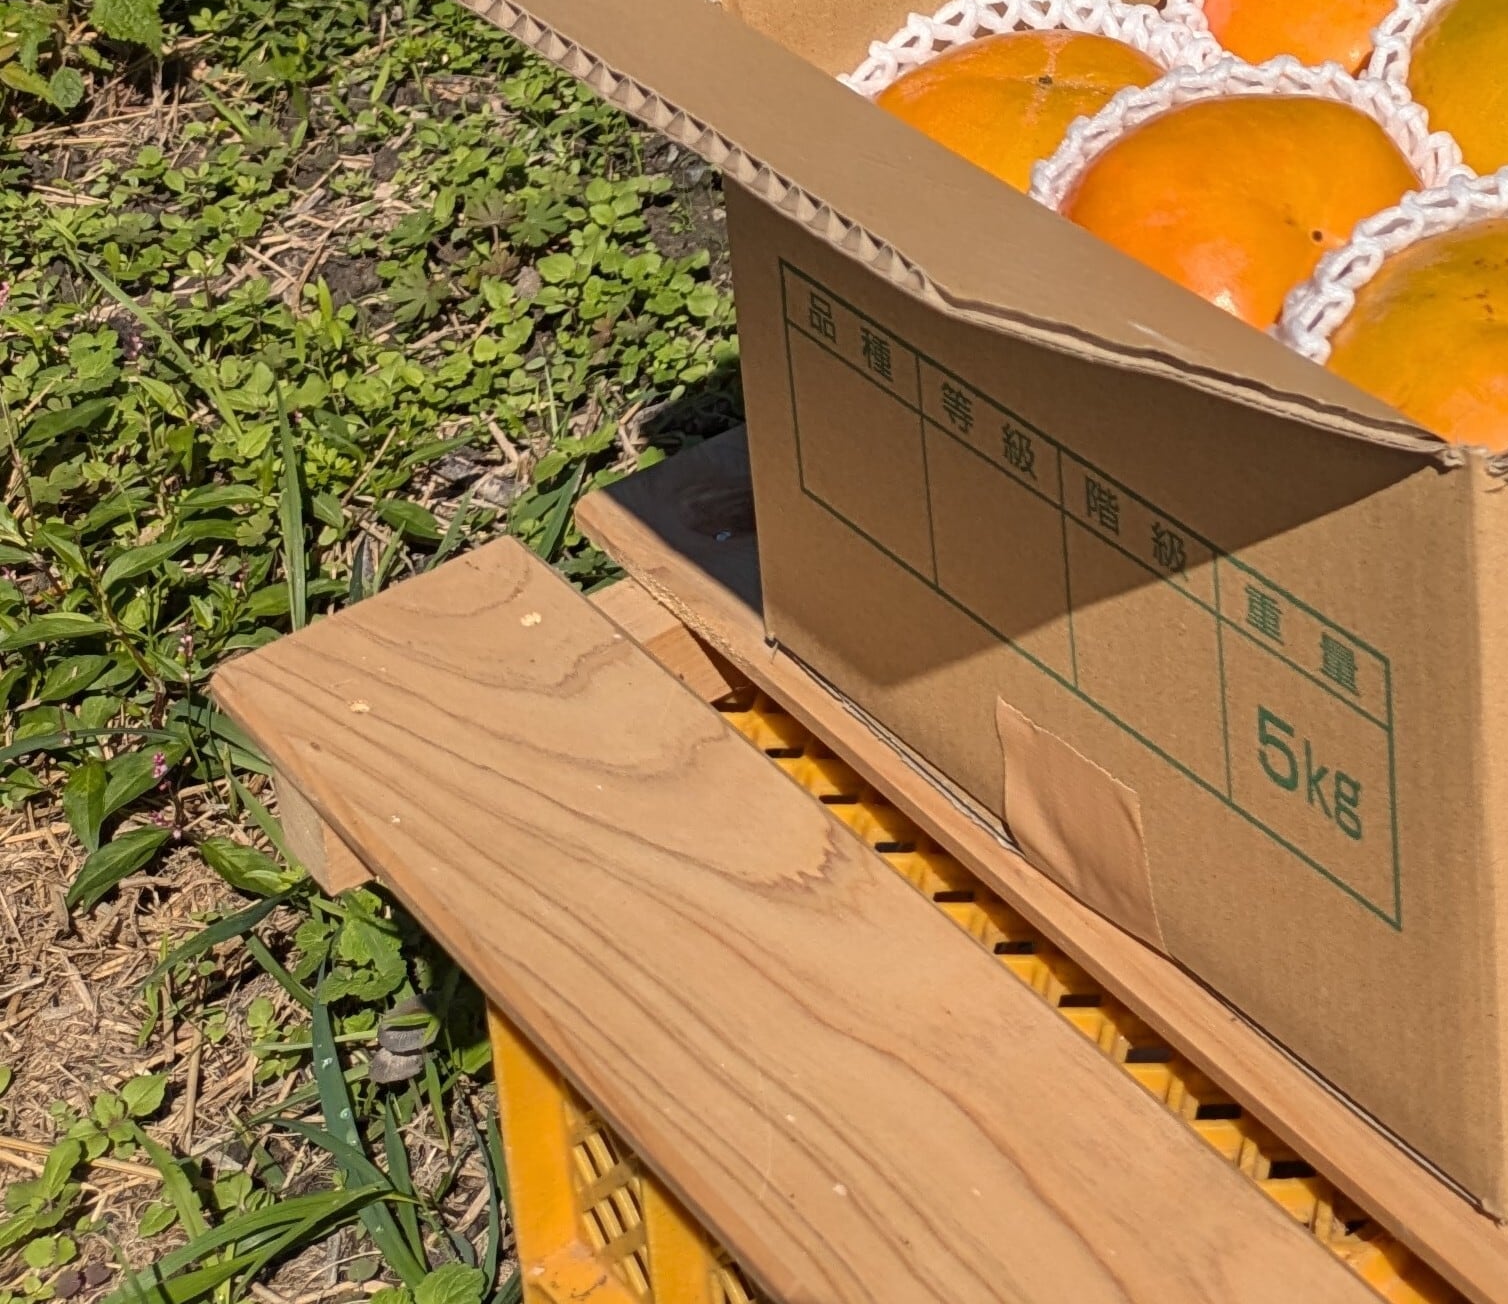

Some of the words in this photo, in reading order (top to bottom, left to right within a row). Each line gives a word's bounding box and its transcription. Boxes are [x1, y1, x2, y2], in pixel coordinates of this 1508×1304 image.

[808, 291, 894, 382] 品種
[942, 381, 1037, 480] 等級
[1085, 475, 1189, 582] 階級
[1244, 582, 1361, 697] 重量
[1257, 703, 1363, 840] 5kg
